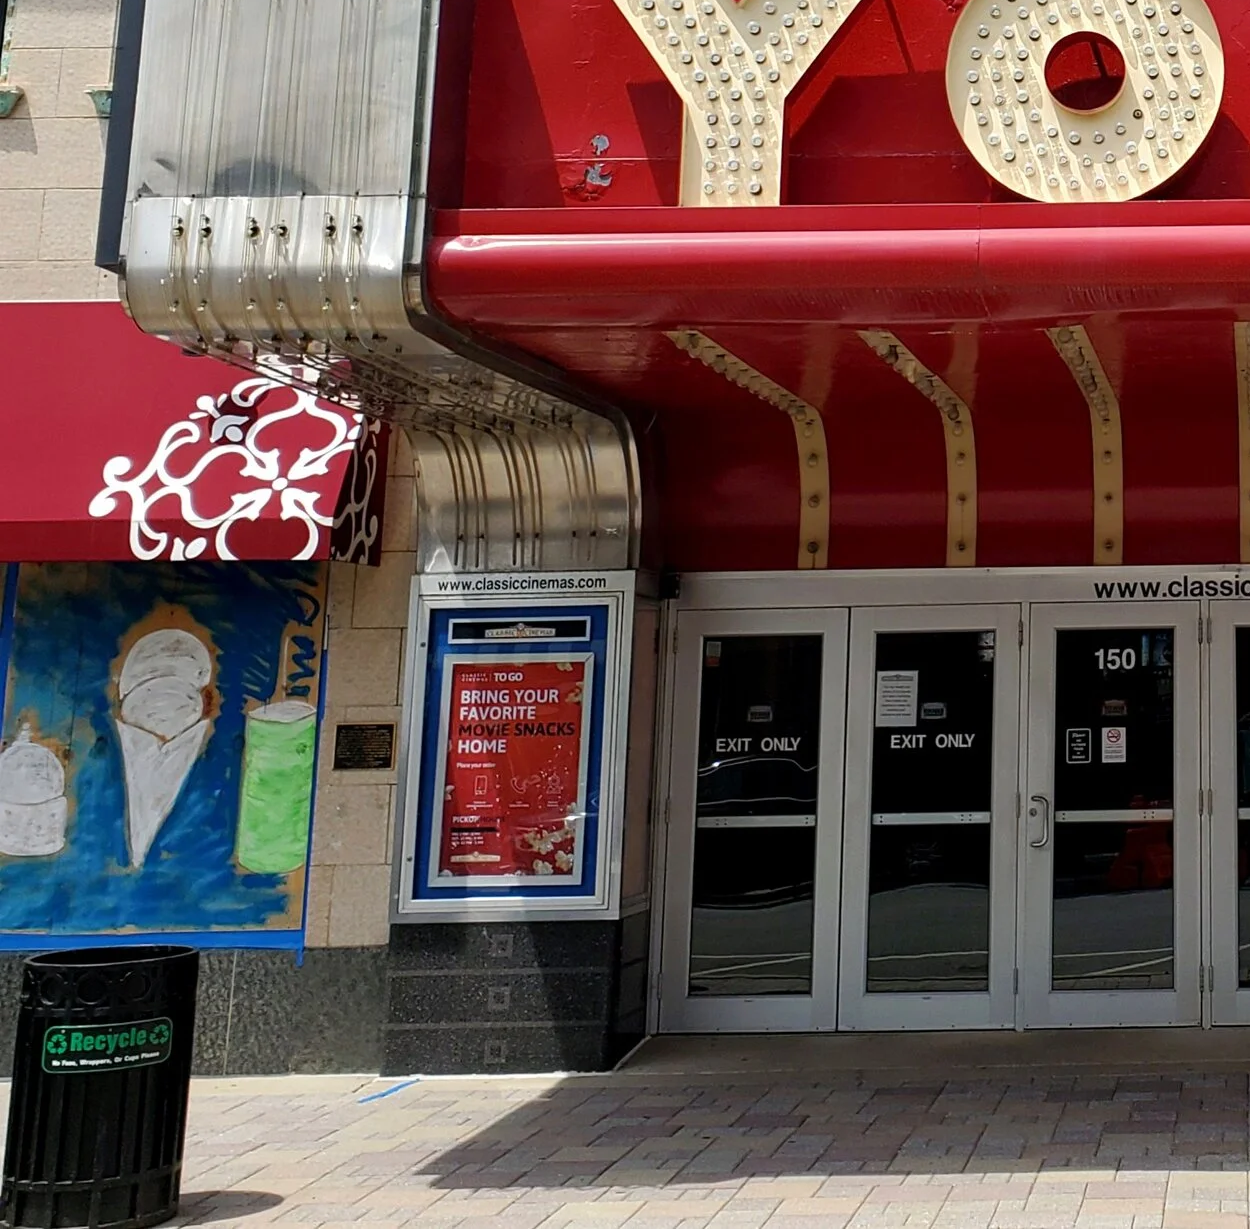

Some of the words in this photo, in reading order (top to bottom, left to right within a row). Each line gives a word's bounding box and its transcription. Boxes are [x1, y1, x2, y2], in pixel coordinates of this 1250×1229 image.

[438, 576, 607, 591] www.classiccinemas.com
[1094, 648, 1136, 670] 150
[493, 672, 507, 682] TO
[508, 672, 524, 681] GO
[460, 690, 510, 704] BRING
[514, 689, 559, 703] YOUR
[459, 706, 537, 720] FAVORITE
[458, 723, 511, 737] MOVIE
[514, 722, 576, 736] SNACKS
[458, 739, 507, 754] HOME
[716, 738, 752, 752] EXIT
[760, 737, 801, 752] ONLY
[890, 734, 926, 749] EXIT
[935, 733, 975, 748] ONLY
[70, 1028, 147, 1054] Recycle
